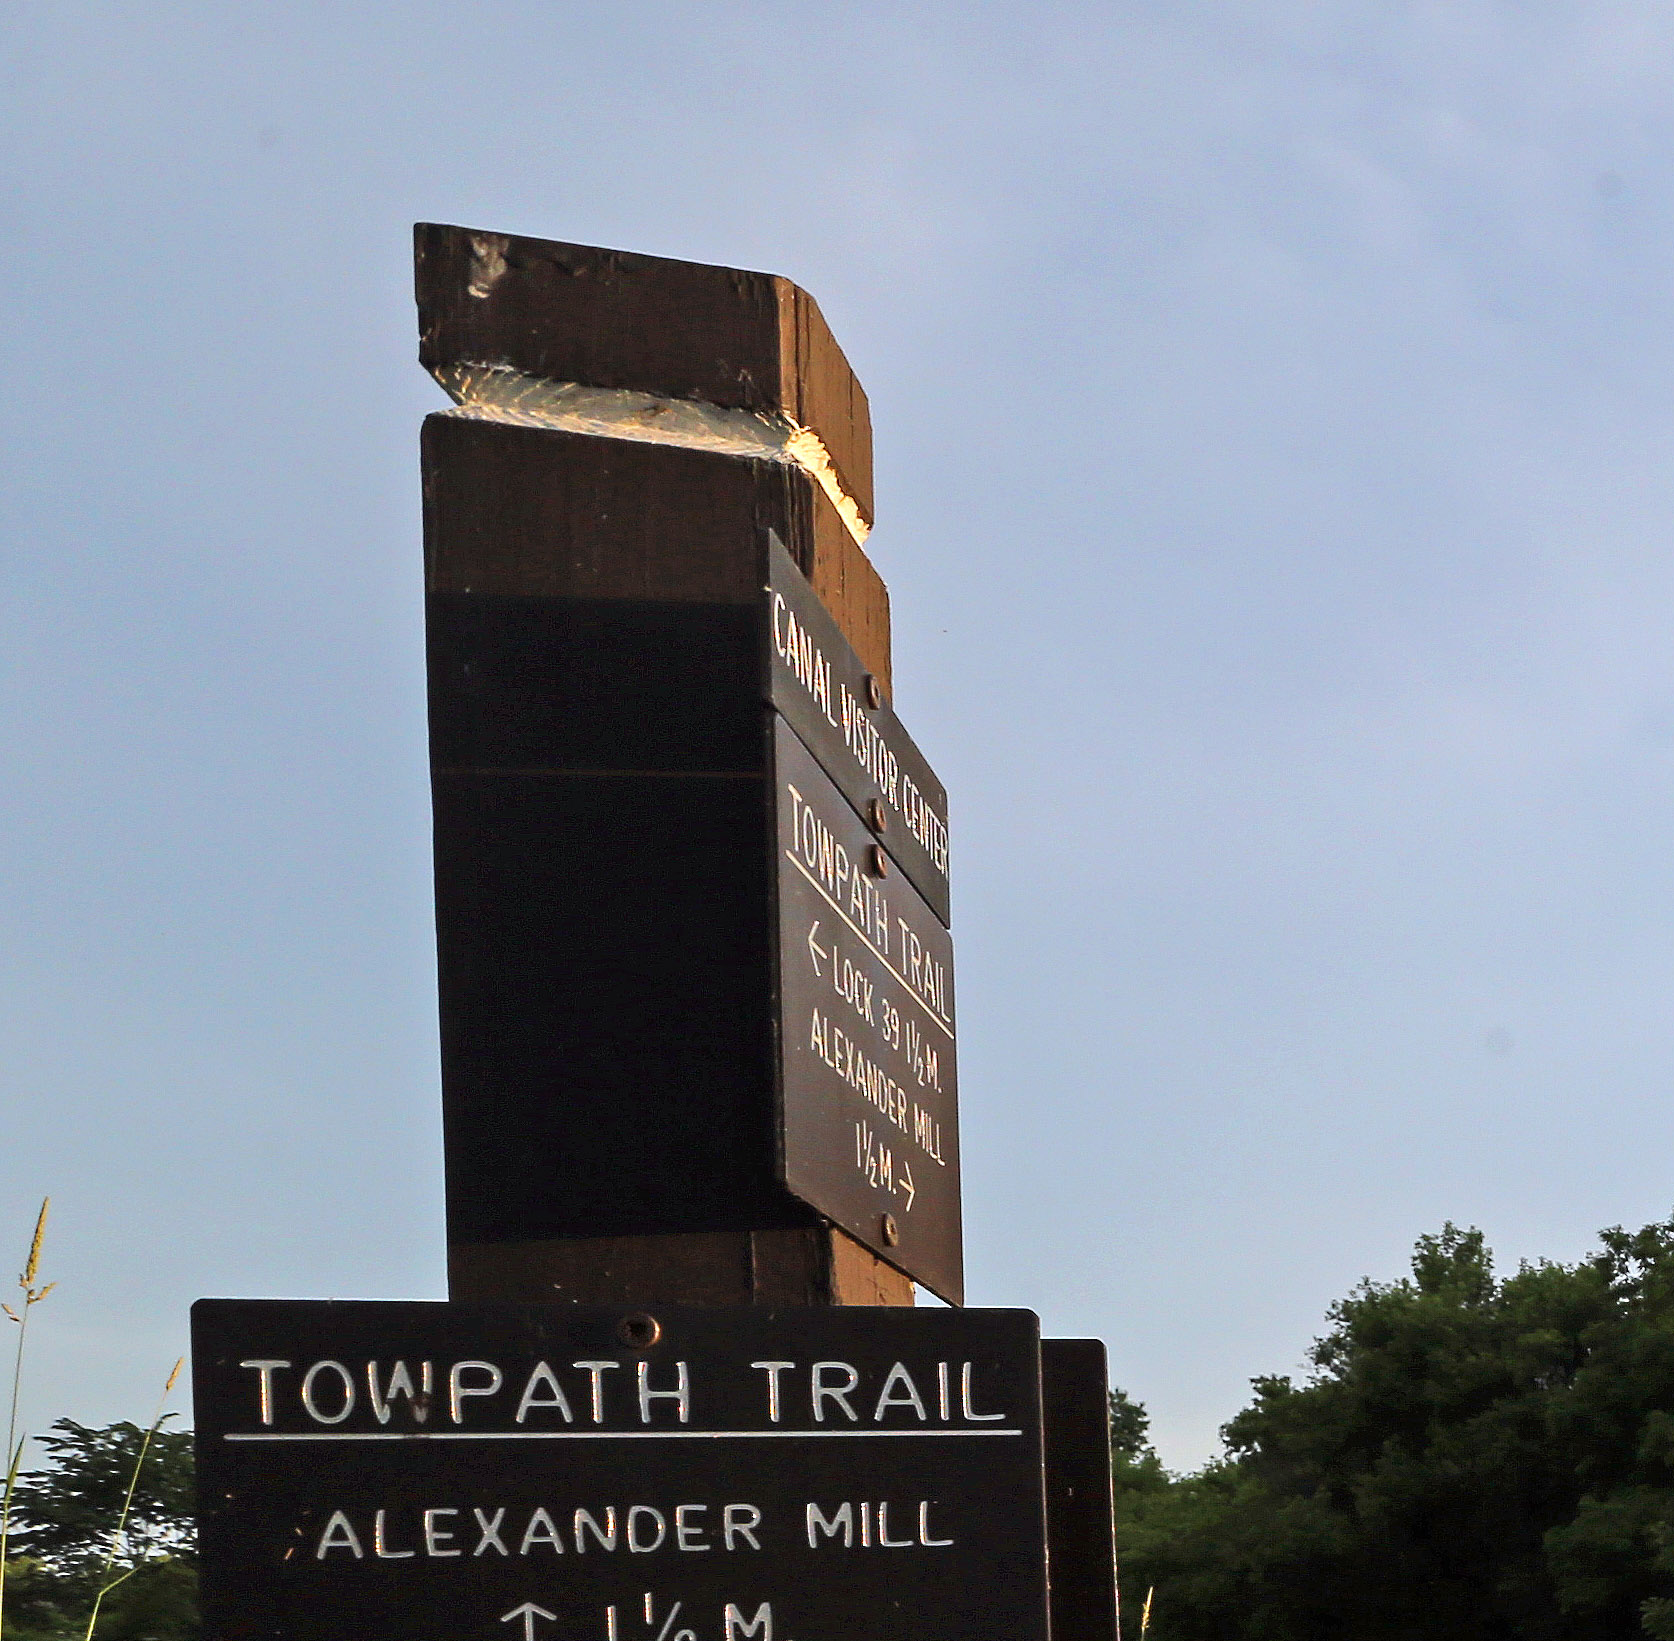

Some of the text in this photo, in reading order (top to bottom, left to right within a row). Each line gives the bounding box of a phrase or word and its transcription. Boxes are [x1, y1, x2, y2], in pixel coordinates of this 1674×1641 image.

[773, 593, 948, 880] CANAL VISITOR CENTER
[788, 784, 952, 1023] TOWPATH TRAIL
[833, 945, 874, 1026] LOCK
[882, 998, 899, 1050] 39
[811, 1008, 946, 1166] ALEXANDER MILL
[240, 1359, 1006, 1425] TOWPATH TRAIL
[316, 1500, 955, 1560] ALEXANDER MILL
